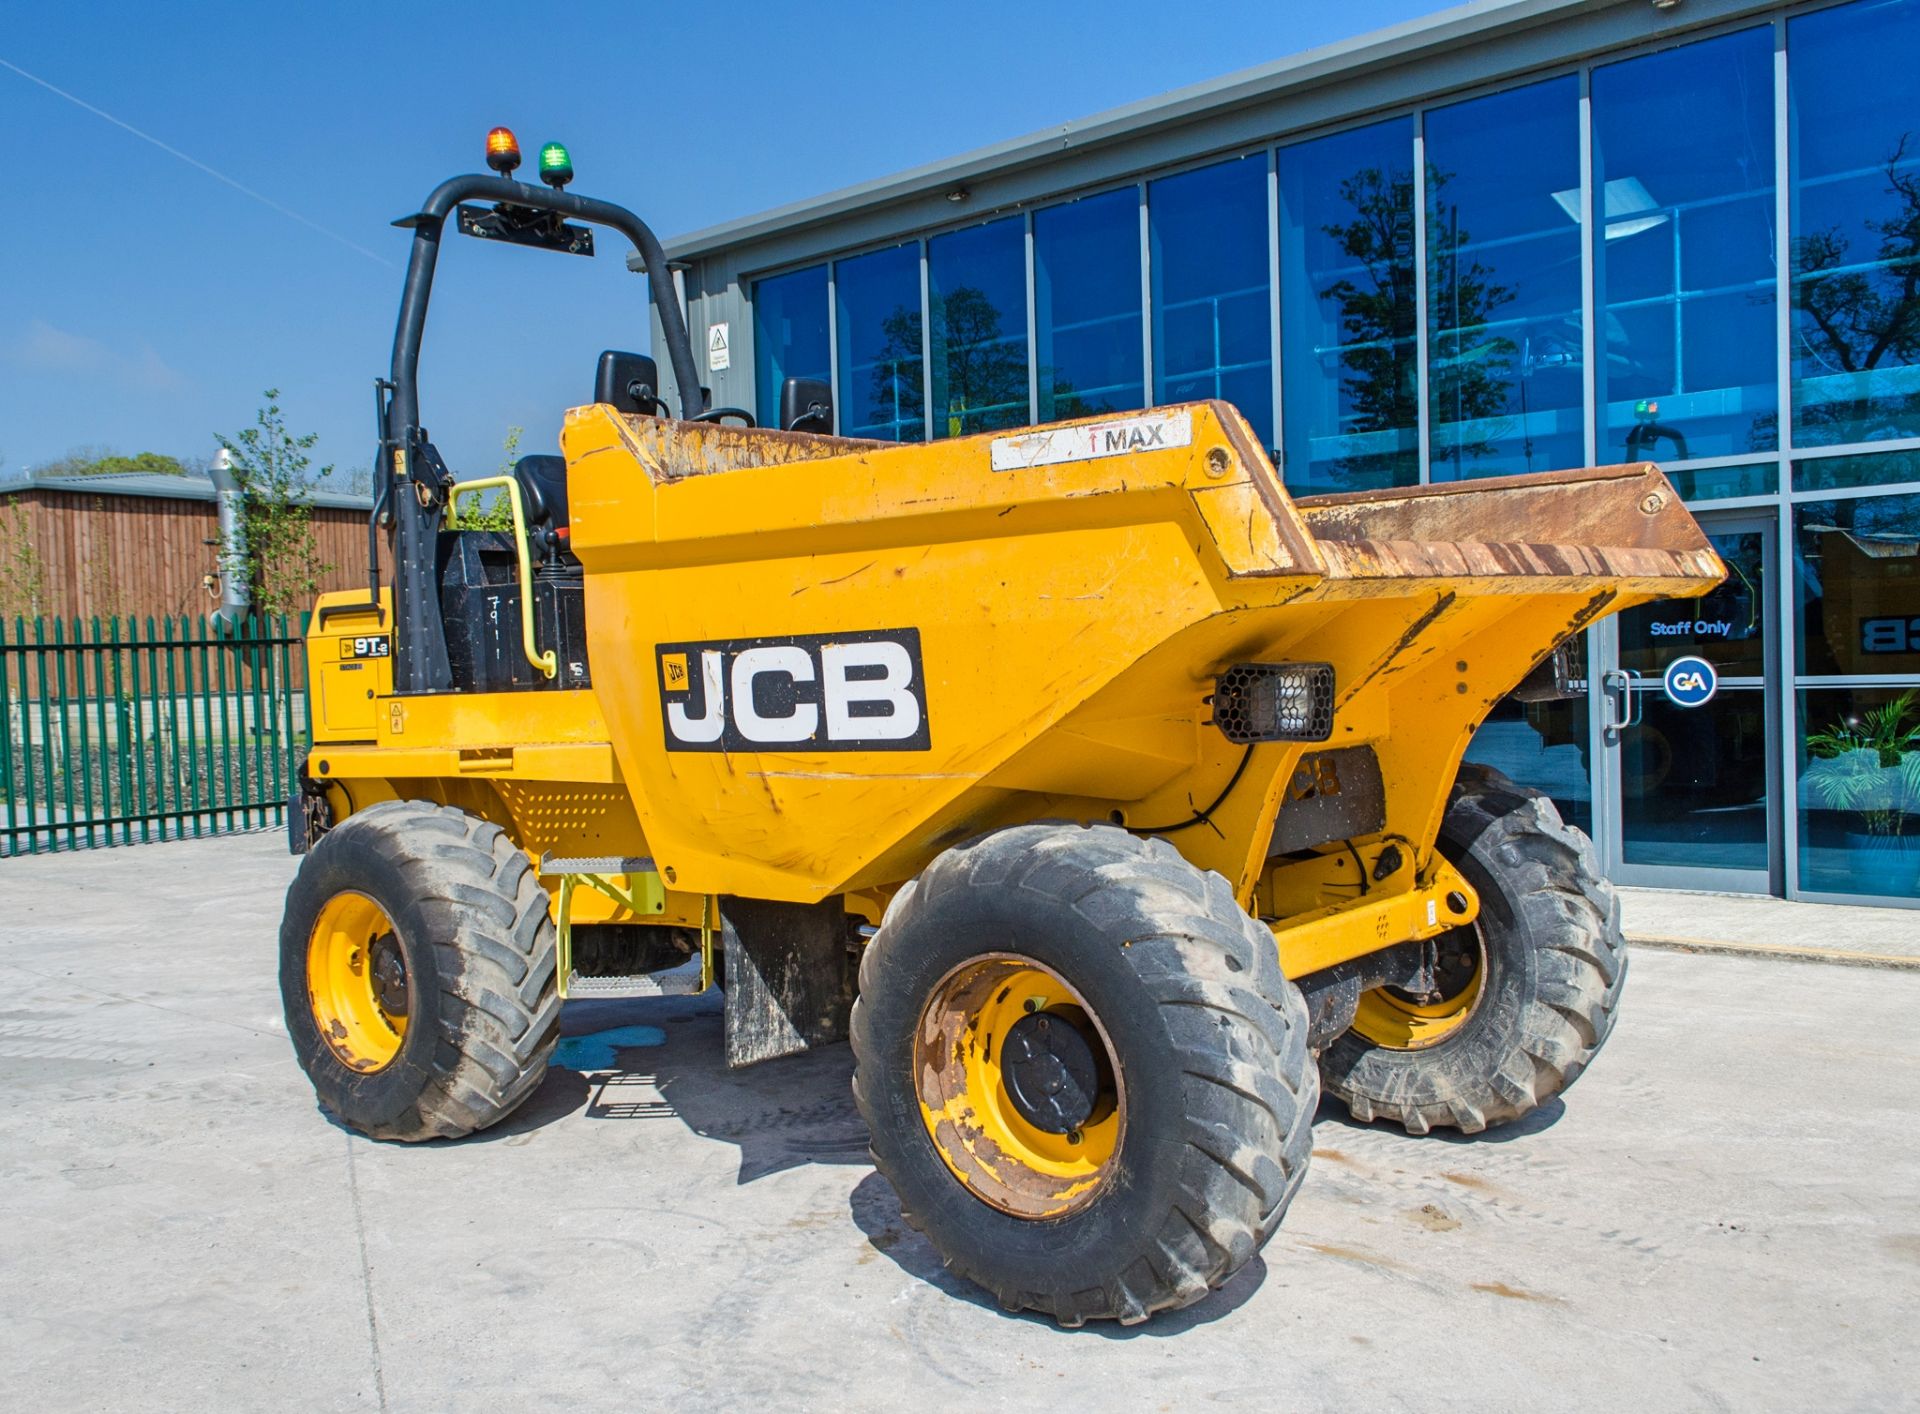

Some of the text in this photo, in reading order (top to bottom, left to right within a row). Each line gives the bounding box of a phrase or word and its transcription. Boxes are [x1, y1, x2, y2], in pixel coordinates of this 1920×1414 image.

[1105, 423, 1164, 453] MAX
[1650, 620, 1732, 636] Staff Only
[667, 641, 920, 742] JCB
[1672, 672, 1707, 691] GA
[1288, 758, 1341, 800] CB
